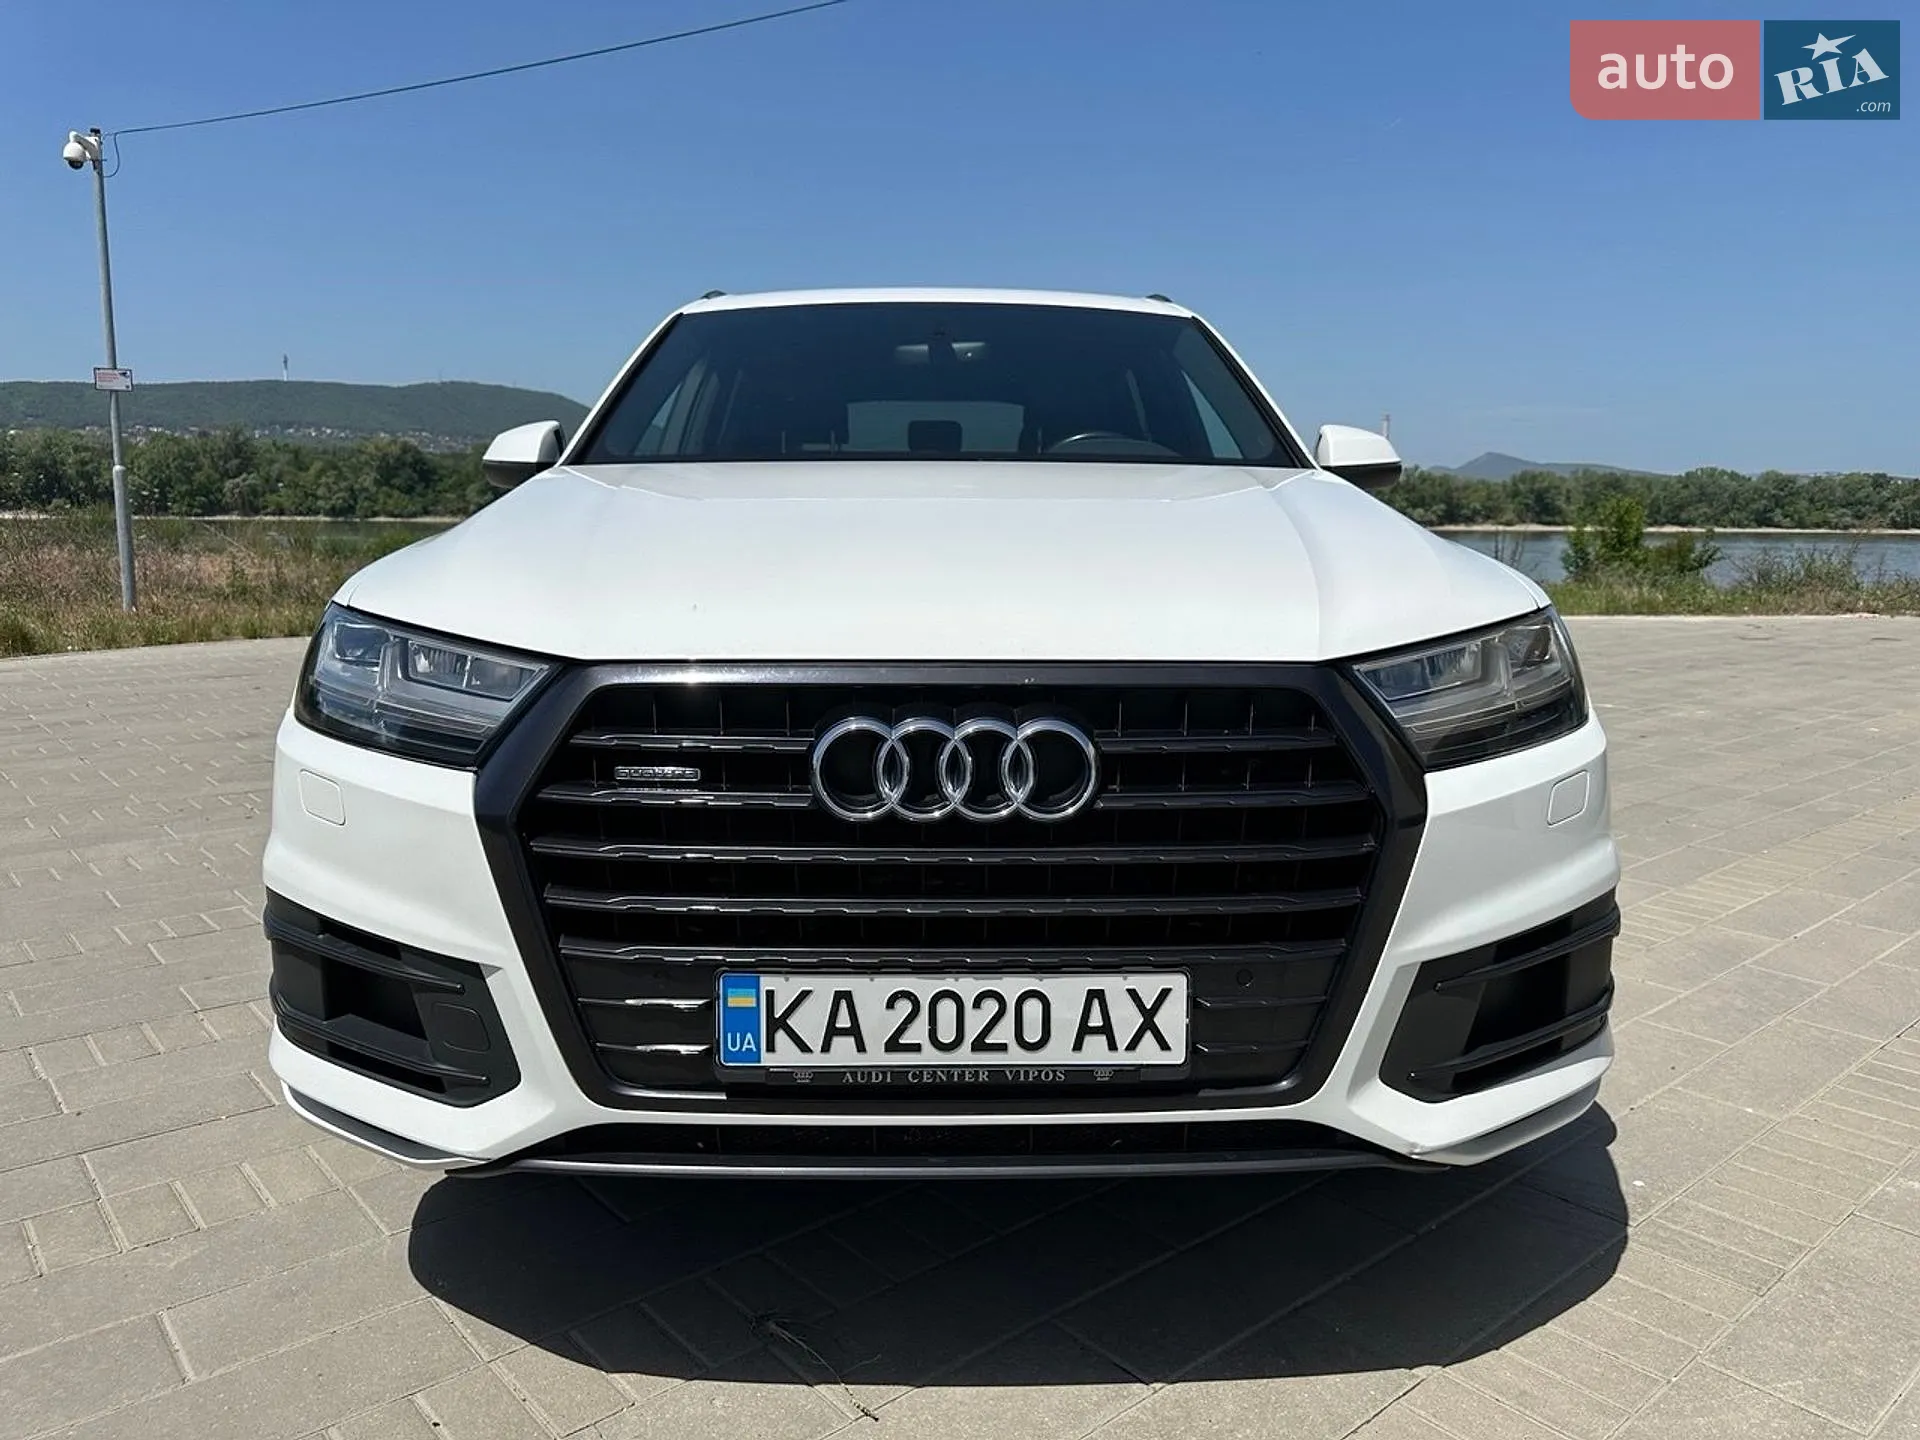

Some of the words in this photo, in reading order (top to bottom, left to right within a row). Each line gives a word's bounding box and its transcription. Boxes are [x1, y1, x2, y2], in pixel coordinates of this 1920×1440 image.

[765, 988, 867, 1053] KA
[884, 989, 1052, 1053] 2020
[1071, 987, 1173, 1052] AX
[727, 1033, 757, 1052] UA
[842, 1071, 892, 1083] AUDI
[908, 1070, 989, 1083] CENTER
[1005, 1069, 1066, 1082] VIPOS
